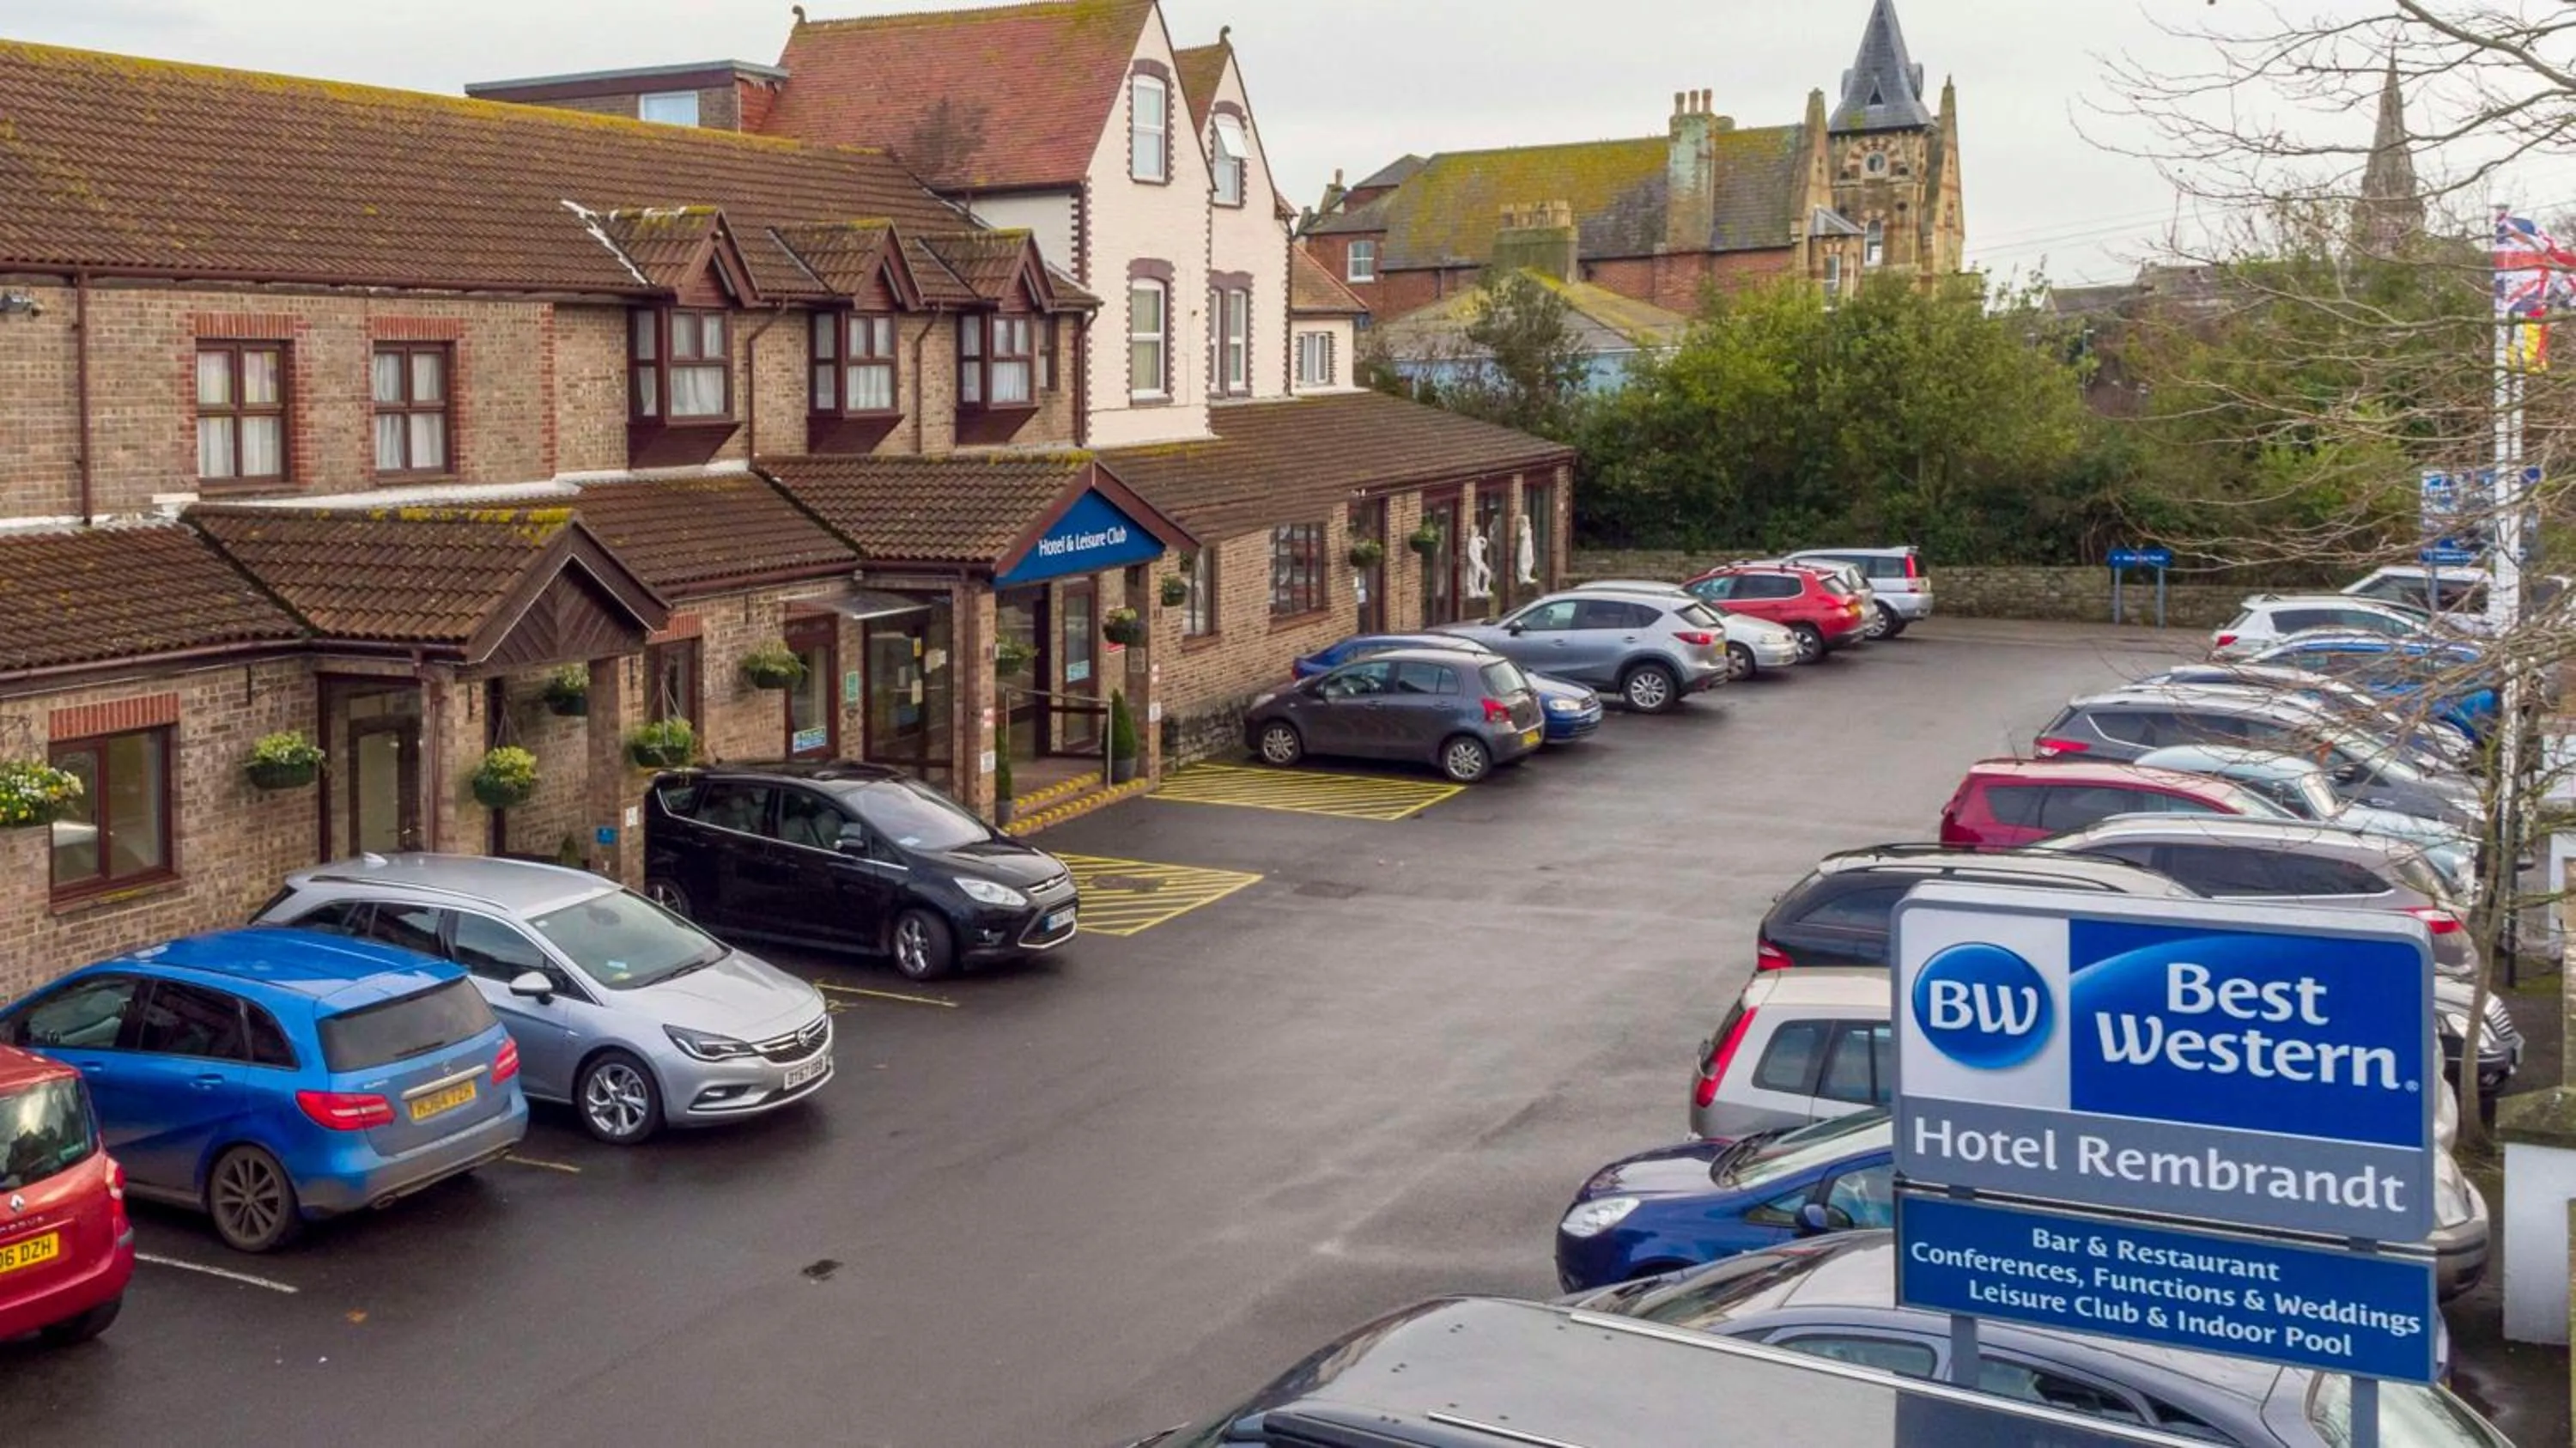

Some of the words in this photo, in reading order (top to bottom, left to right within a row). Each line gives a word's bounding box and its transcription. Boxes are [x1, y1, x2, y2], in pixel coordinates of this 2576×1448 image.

[1038, 536, 1065, 557] Hotel
[1066, 534, 1074, 551] &
[1075, 531, 1106, 550] Leisure
[1108, 525, 1127, 545] Club
[1929, 980, 2038, 1036] BW
[2166, 962, 2330, 1025] Best
[2094, 1011, 2401, 1091] Western
[1915, 1116, 2058, 1171] Hotel
[2079, 1135, 2407, 1213] Rembrandt
[21, 1237, 52, 1262] DZH
[2032, 1228, 2081, 1254] Bar
[2087, 1236, 2108, 1258] &
[2117, 1238, 2281, 1281] Restaurant
[1911, 1241, 2085, 1288] Conferences,
[2093, 1267, 2236, 1307] Functions
[2243, 1289, 2266, 1311] &
[2274, 1292, 2421, 1337] Weddings
[1969, 1279, 2067, 1313] Leisure
[2075, 1295, 2140, 1323] Club
[2147, 1306, 2169, 1329] &
[2177, 1310, 2278, 1344] Indoor
[2285, 1325, 2354, 1357] Pool
